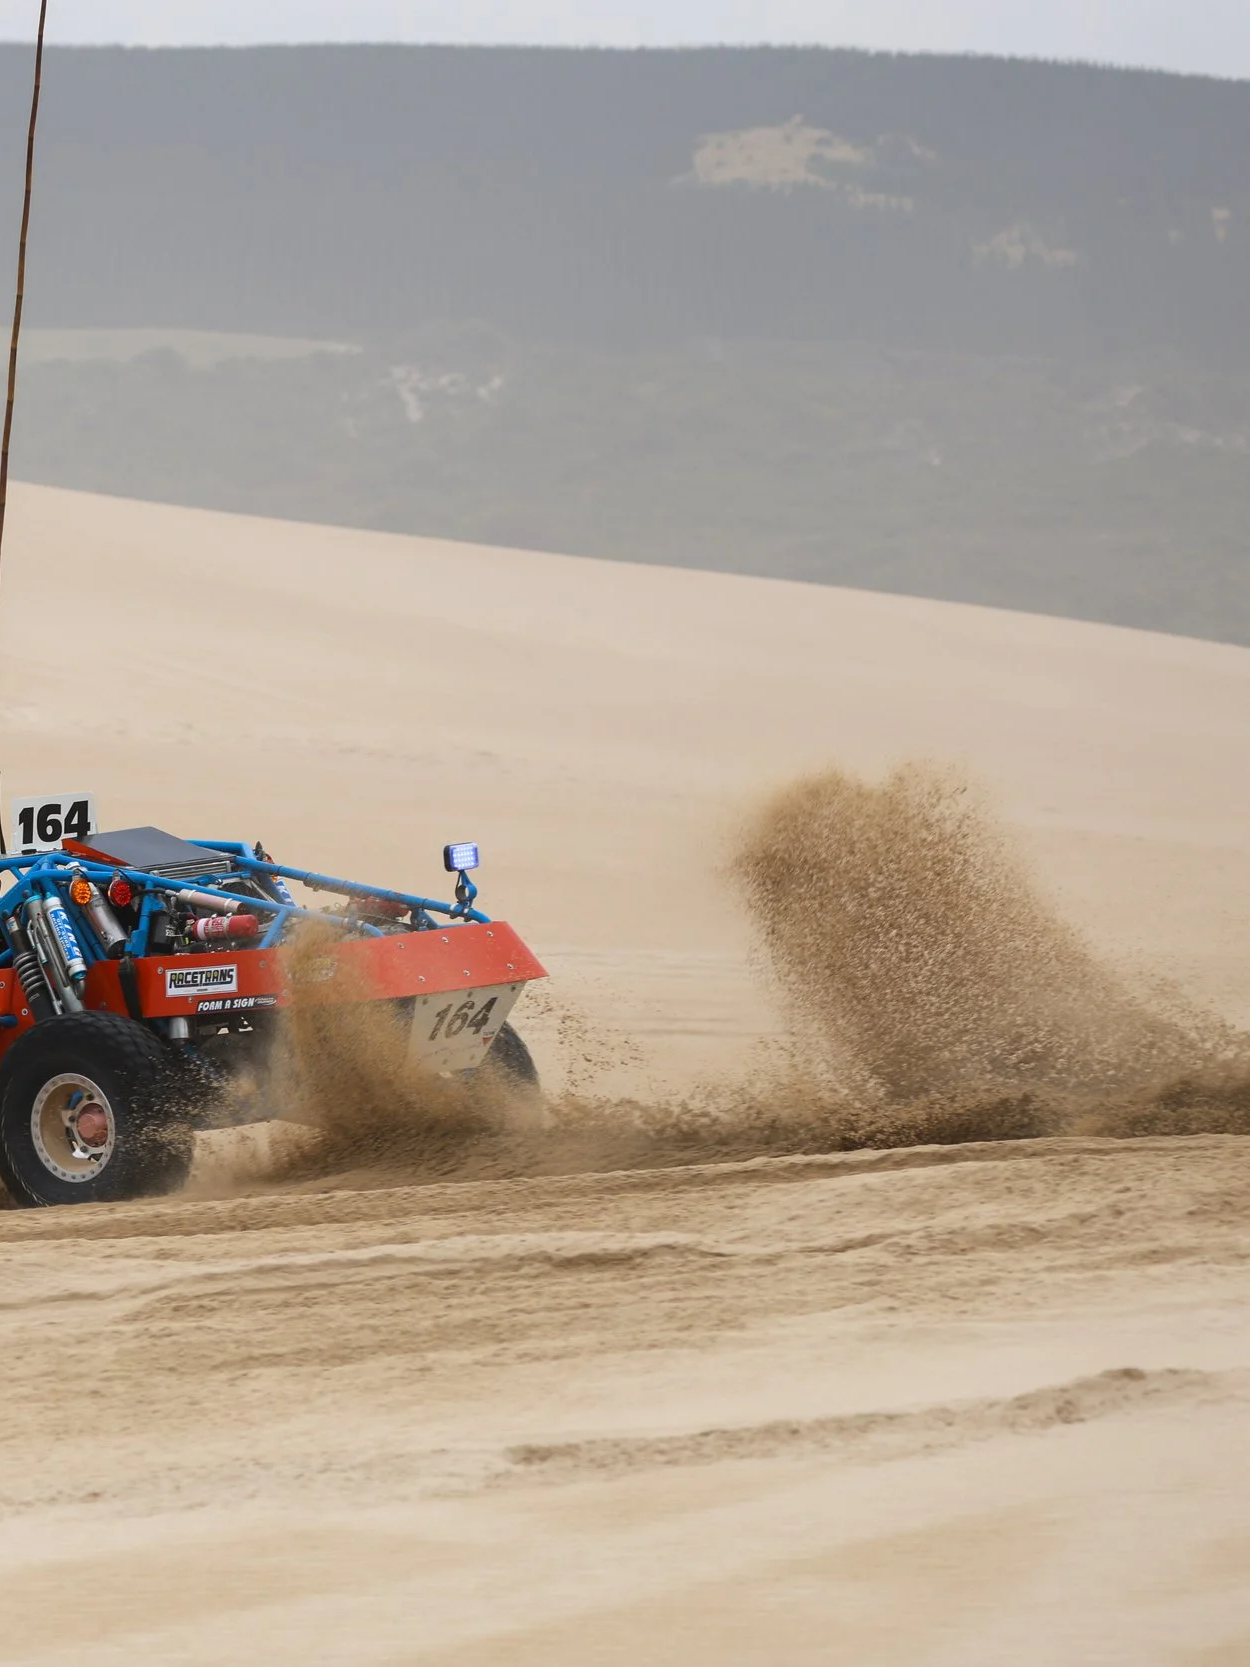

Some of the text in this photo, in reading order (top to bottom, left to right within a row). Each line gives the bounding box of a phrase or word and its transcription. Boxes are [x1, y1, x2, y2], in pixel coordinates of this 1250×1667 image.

[19, 800, 91, 845] 164
[59, 911, 83, 957] KING
[169, 968, 234, 988] RACETRANS
[198, 1001, 223, 1012] FORM
[232, 998, 255, 1009] SIGN
[428, 997, 498, 1040] 164
